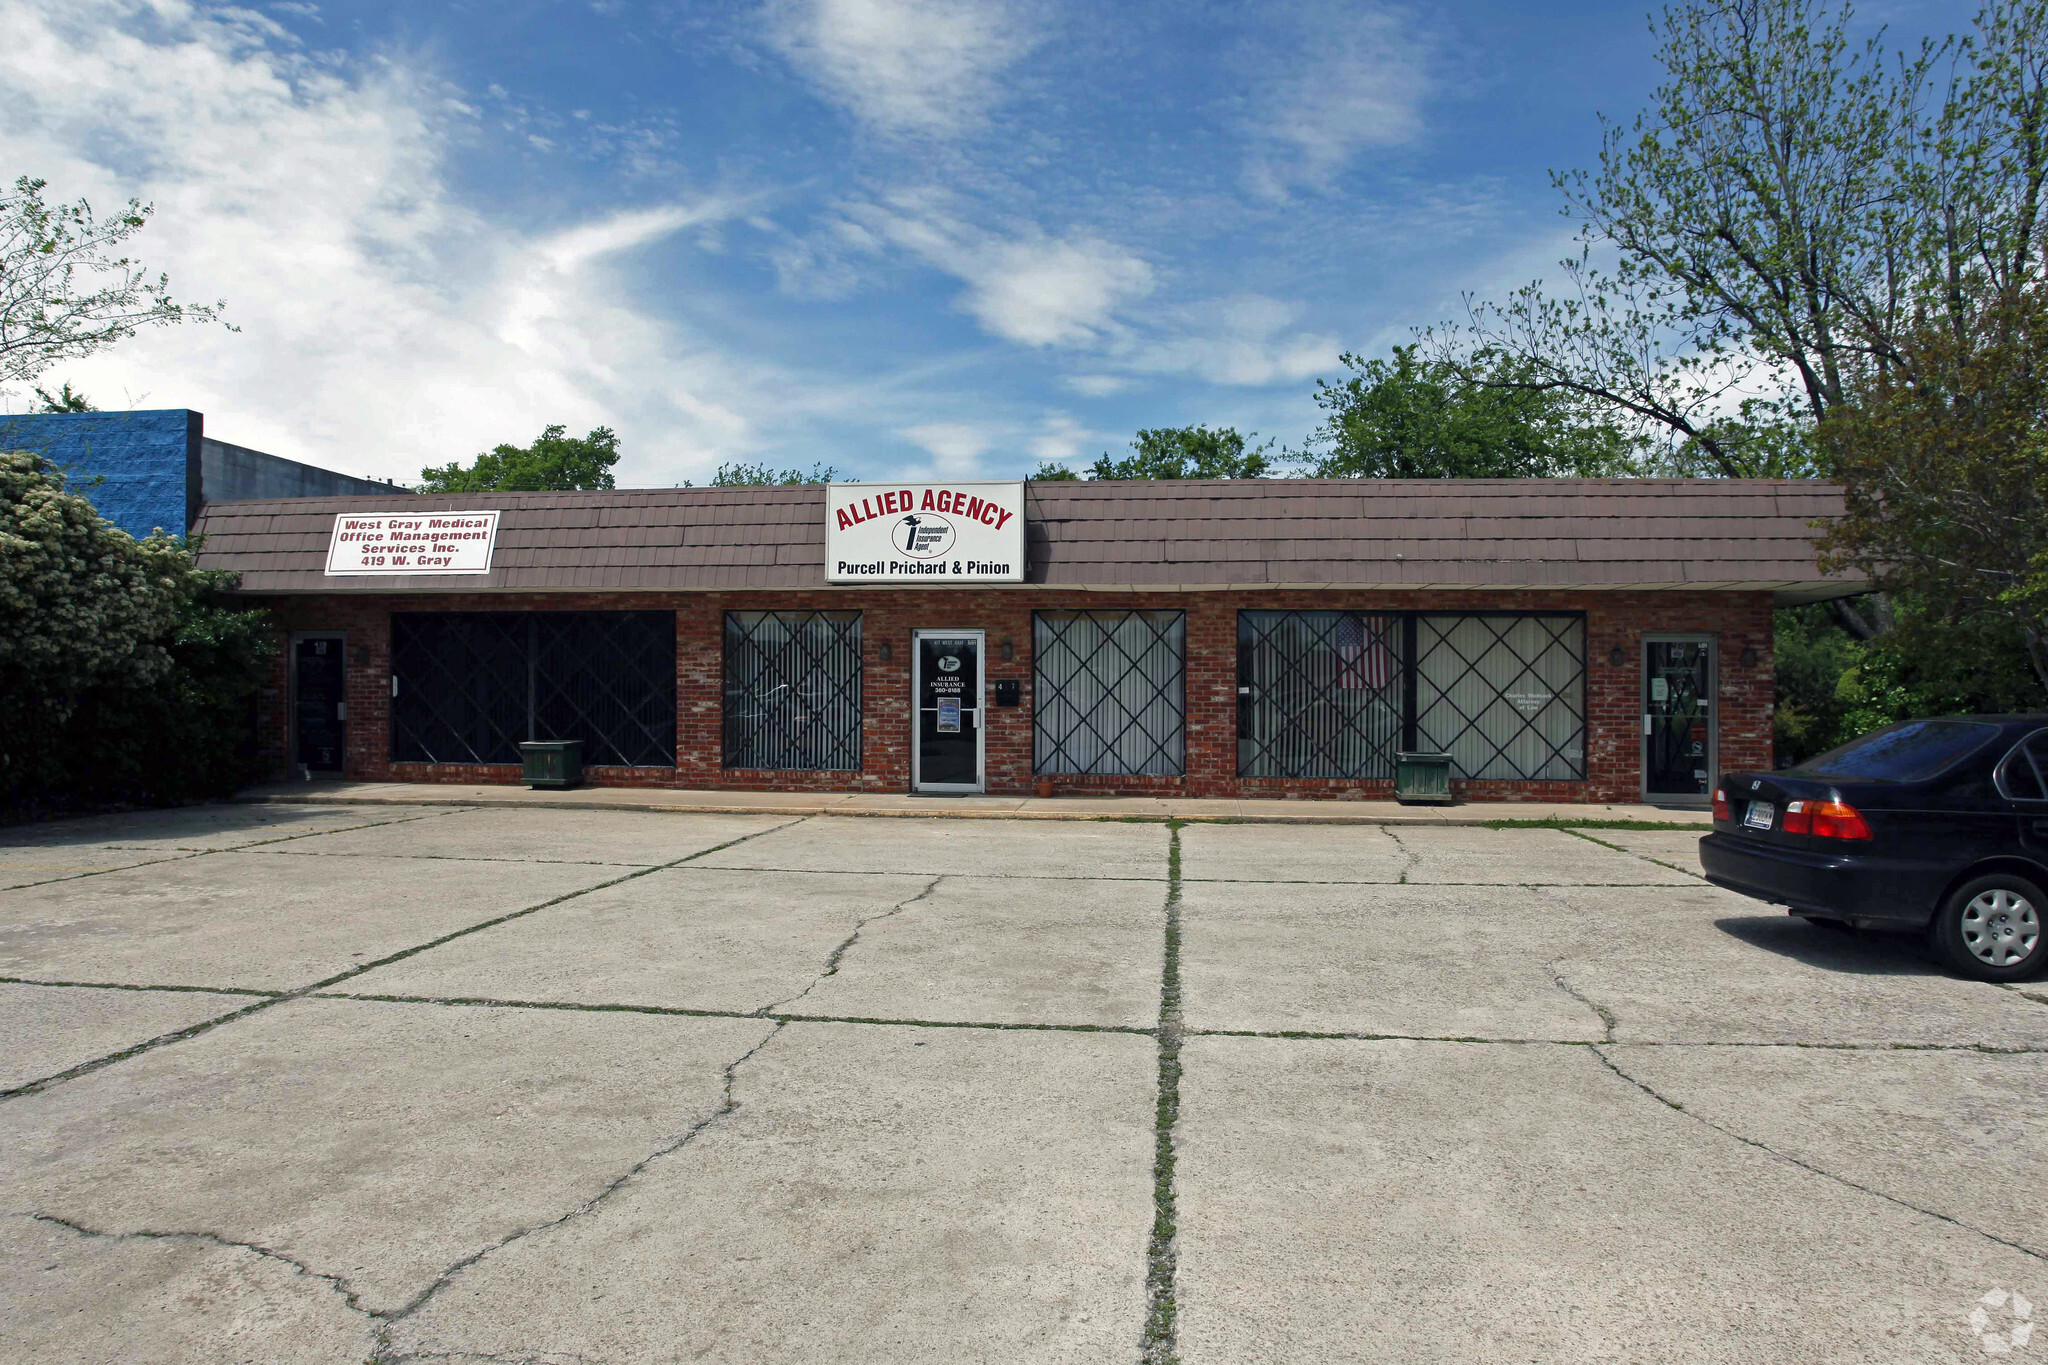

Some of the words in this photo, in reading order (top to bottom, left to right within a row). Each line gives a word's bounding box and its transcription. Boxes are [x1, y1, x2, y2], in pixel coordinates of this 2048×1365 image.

[836, 489, 914, 532] ALLIED
[920, 488, 1014, 531] AGENCY
[345, 520, 382, 530] West
[388, 519, 422, 531] Gray
[428, 518, 489, 529] Medical
[918, 526, 949, 535] Independent
[340, 532, 384, 542] Office
[390, 530, 488, 543] Management
[361, 543, 426, 554] Services
[432, 543, 460, 553] Inc.
[914, 543, 929, 551] Agent
[361, 556, 385, 566] 419
[392, 556, 411, 565] W.
[417, 555, 452, 567] Gray
[837, 560, 885, 575] Purcell
[889, 560, 946, 575] Prichard
[952, 561, 963, 575] &
[967, 560, 1010, 575] Pinion
